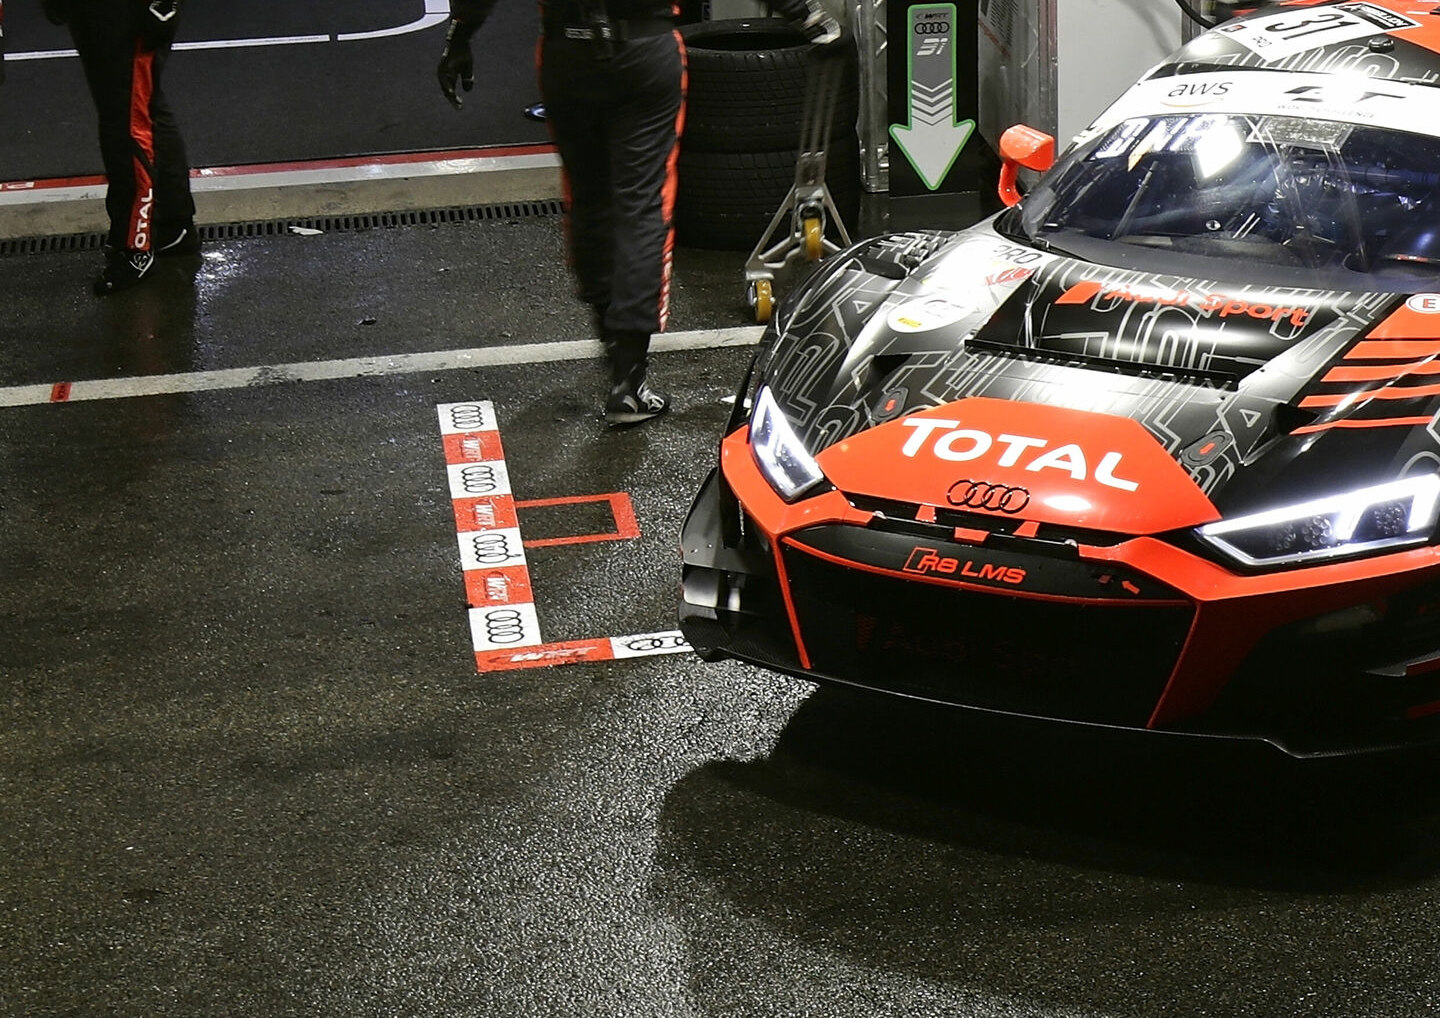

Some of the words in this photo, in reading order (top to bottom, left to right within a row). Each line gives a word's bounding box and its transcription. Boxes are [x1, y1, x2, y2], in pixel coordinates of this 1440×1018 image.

[1266, 13, 1360, 40] 31
[916, 37, 949, 56] 31
[1167, 81, 1233, 99] aws
[131, 188, 153, 249] OTAL
[1103, 283, 1188, 306] Audi
[1200, 293, 1309, 327] Sport
[902, 417, 1140, 492] TOTAL
[918, 554, 959, 574] R8
[961, 560, 1027, 584] LMS
